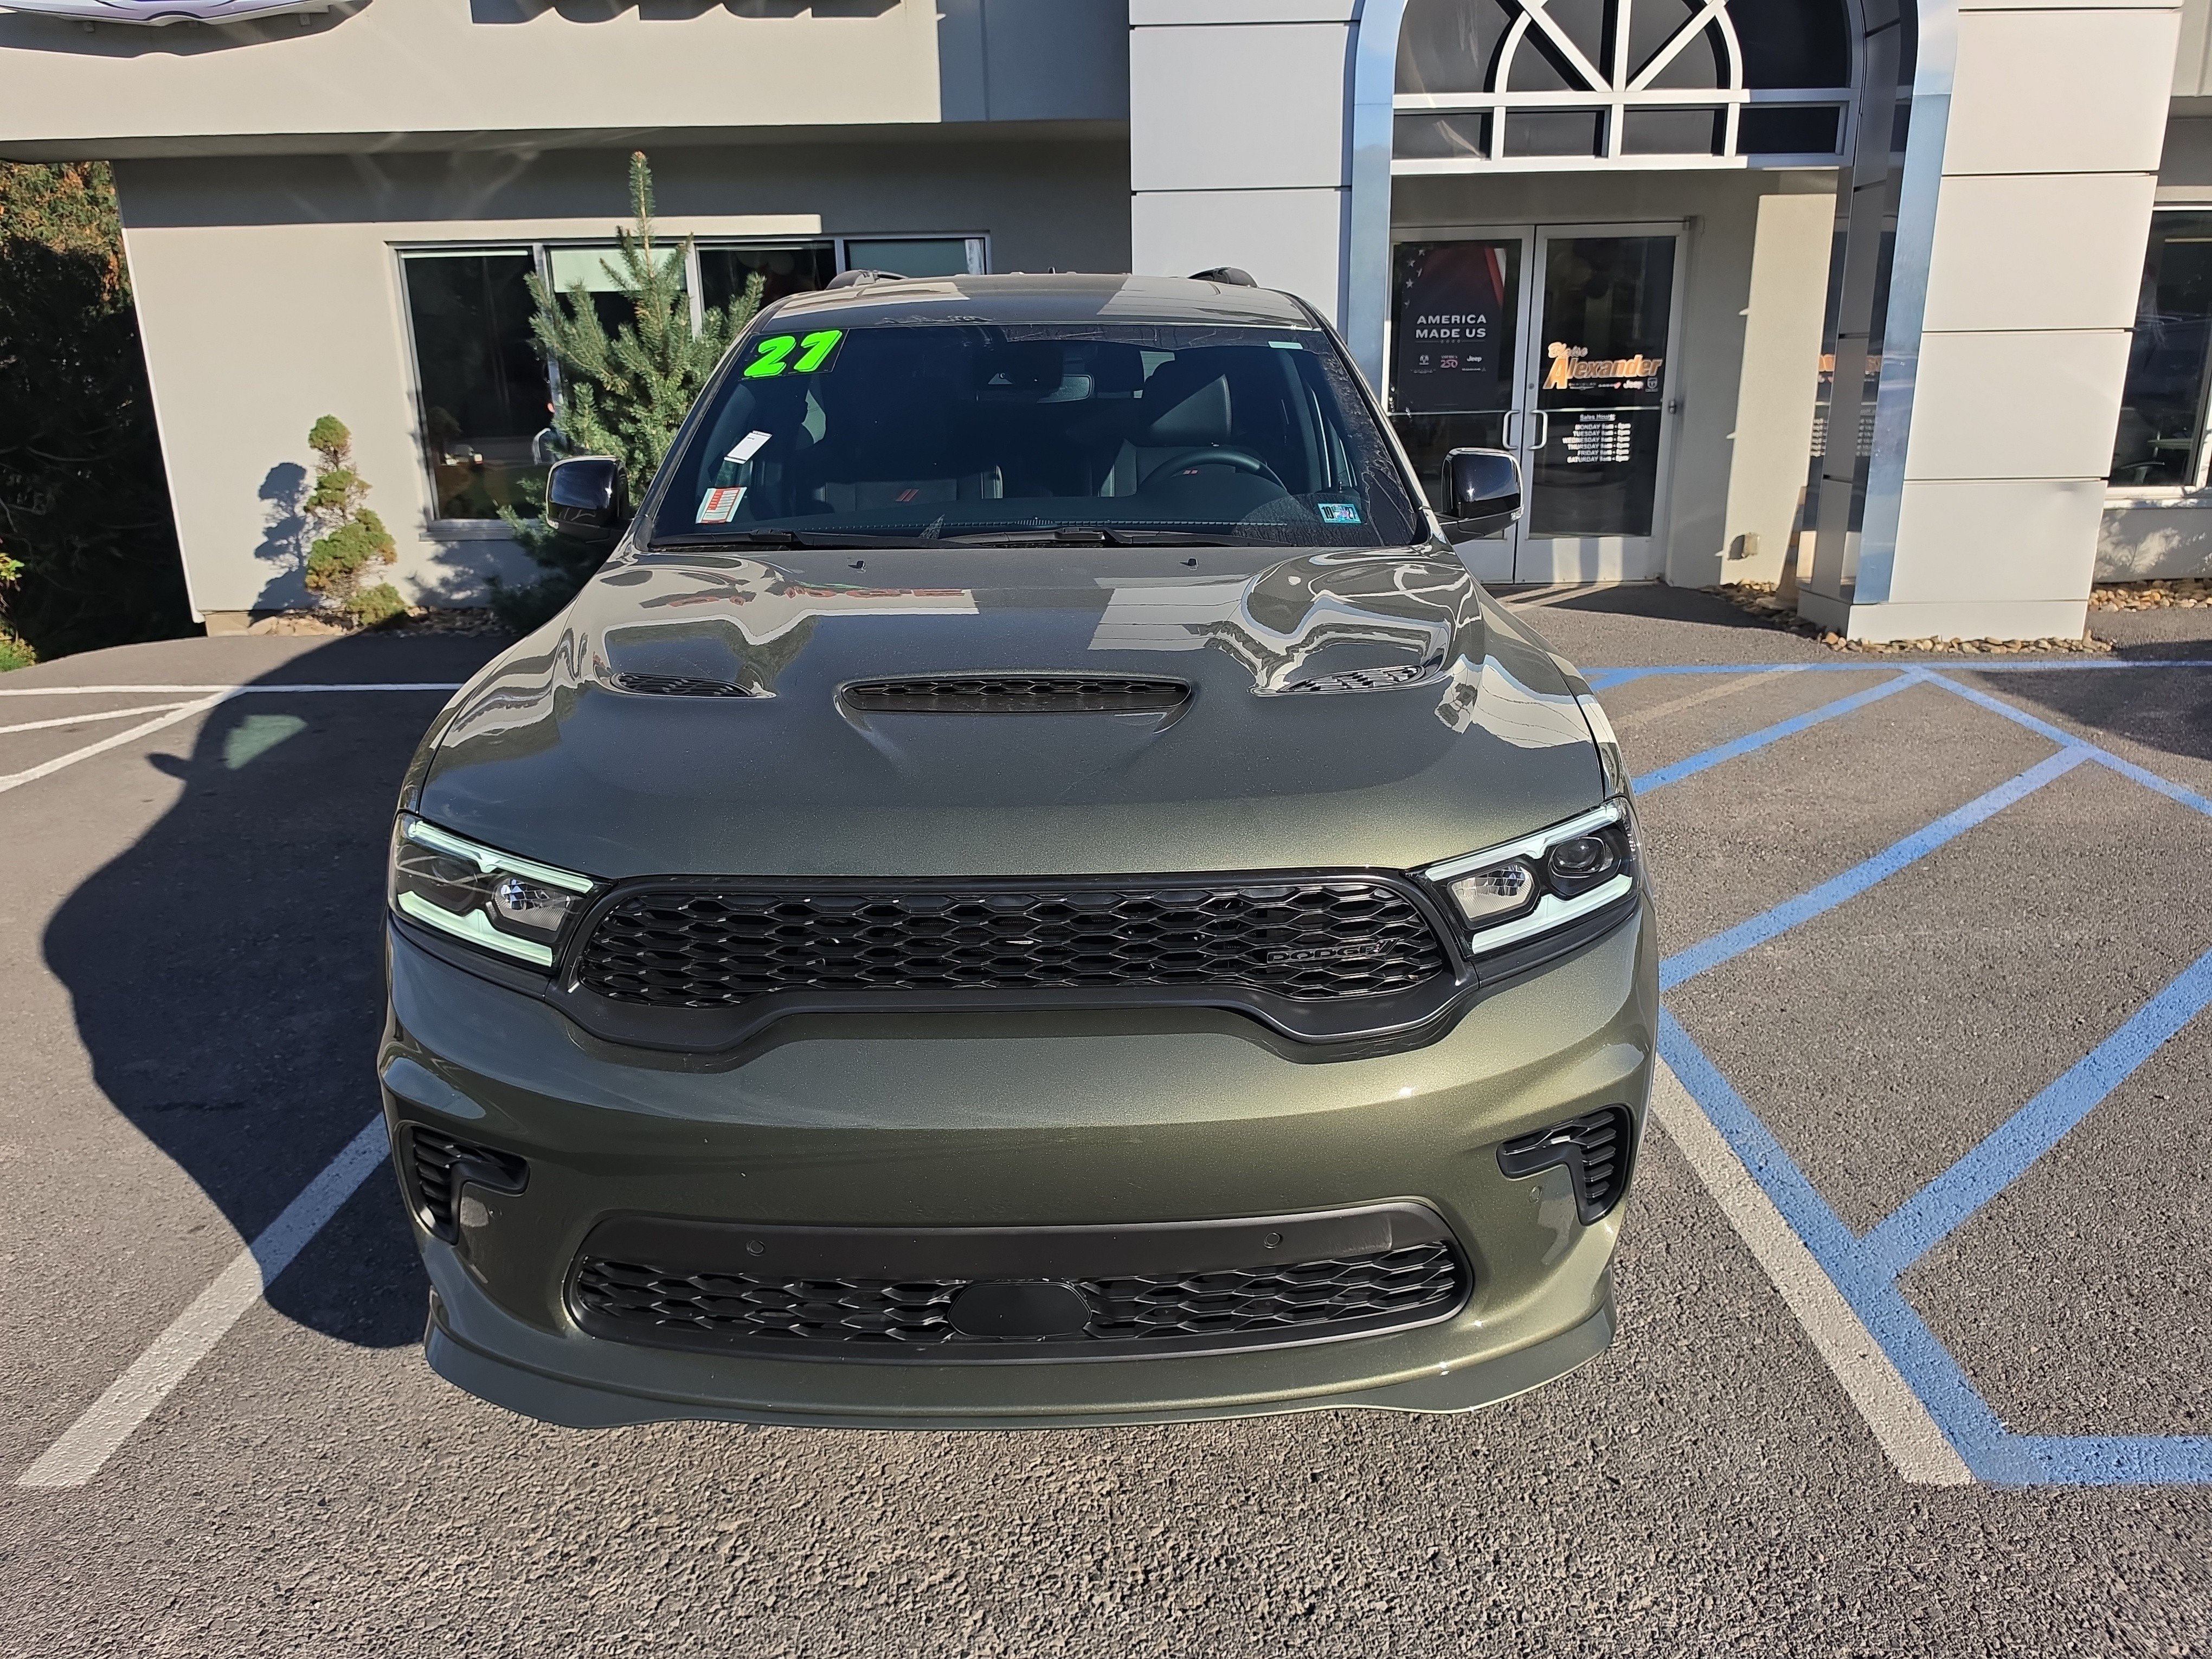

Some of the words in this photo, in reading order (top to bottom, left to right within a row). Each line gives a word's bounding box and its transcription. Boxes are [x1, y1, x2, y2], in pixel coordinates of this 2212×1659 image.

[1417, 314, 1487, 325] AMERICA
[1416, 329, 1461, 338] MADE
[1465, 328, 1486, 338] US
[744, 330, 843, 377] 27
[1440, 359, 1458, 368] 250
[1542, 354, 1663, 389] Alexander
[1321, 506, 1335, 519] 10
[1268, 945, 1379, 962] DODGE
